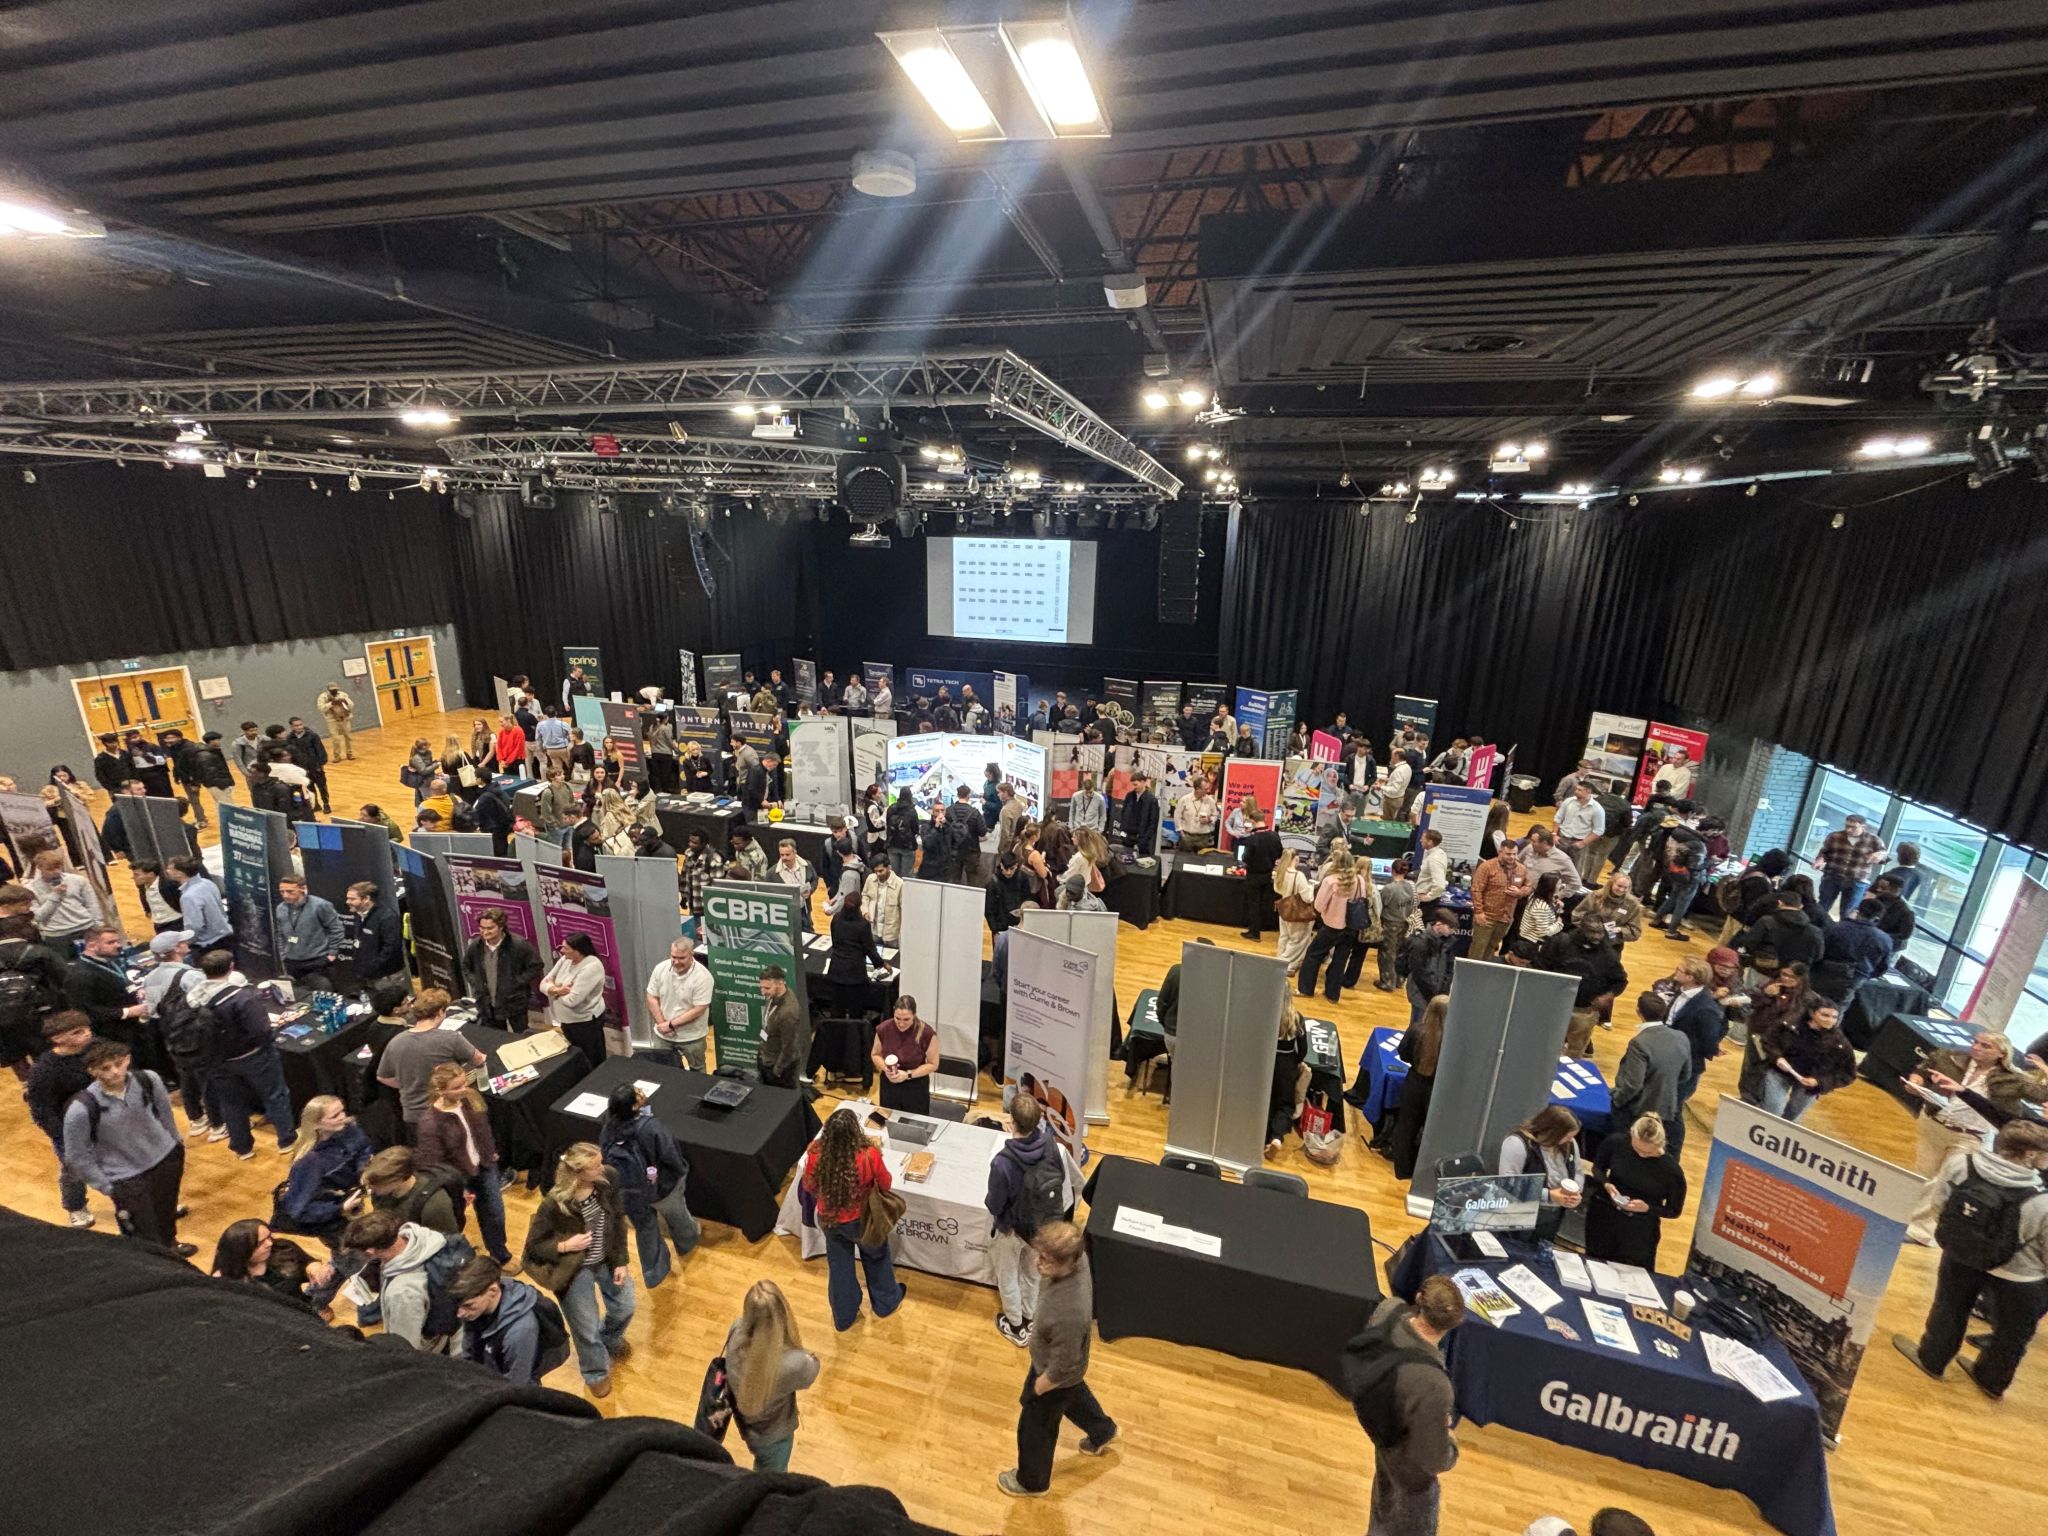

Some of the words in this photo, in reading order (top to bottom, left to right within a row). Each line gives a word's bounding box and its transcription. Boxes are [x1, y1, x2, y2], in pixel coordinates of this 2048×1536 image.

[569, 656, 598, 667] spring
[675, 714, 720, 725] LANTERN
[730, 720, 774, 731] LANTERN
[707, 897, 789, 926] CBRE
[1014, 979, 1030, 989] Start
[1031, 985, 1047, 996] your
[1047, 992, 1070, 1004] career
[1014, 989, 1028, 998] with
[1029, 992, 1050, 1006] Currie
[1050, 1001, 1056, 1009] &
[1058, 1004, 1080, 1018] Brown
[1311, 1026, 1329, 1054] GFW
[1748, 1124, 1877, 1197] Galbraith
[1465, 1198, 1509, 1210] Galbraith
[1724, 1204, 1770, 1231] Local
[896, 1218, 934, 1232] CURRIE
[896, 1226, 904, 1234] &
[906, 1229, 949, 1244] BROWN
[1723, 1215, 1792, 1253] National
[1721, 1224, 1826, 1285] International
[1540, 1380, 1740, 1461] Galbraith
